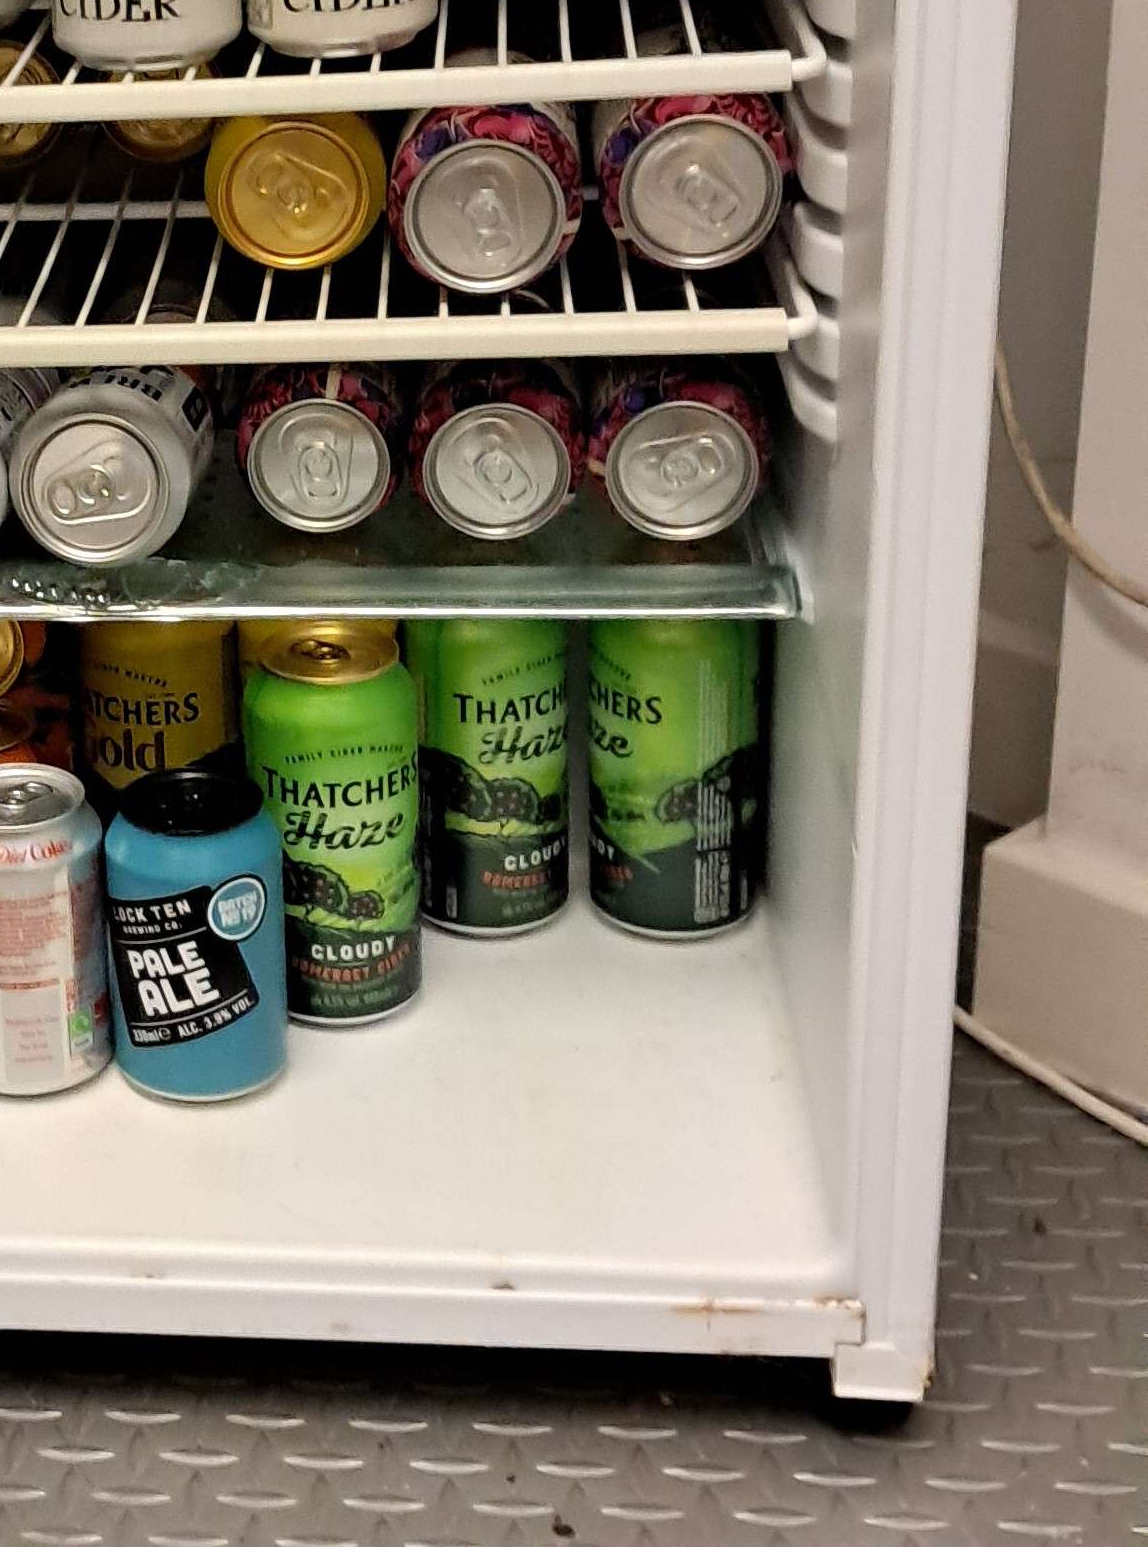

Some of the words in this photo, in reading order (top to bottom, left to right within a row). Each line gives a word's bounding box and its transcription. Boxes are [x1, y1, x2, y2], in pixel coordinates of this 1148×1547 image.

[452, 681, 563, 725] THATCH
[589, 674, 663, 725] CHERS
[100, 728, 166, 771] old
[477, 724, 564, 764] Haz
[593, 718, 633, 758] ze
[283, 810, 404, 850] Haze
[150, 899, 192, 921] TEN
[127, 941, 206, 979] PALE
[311, 934, 396, 961] CLOUDY
[138, 967, 221, 1017] ALE
